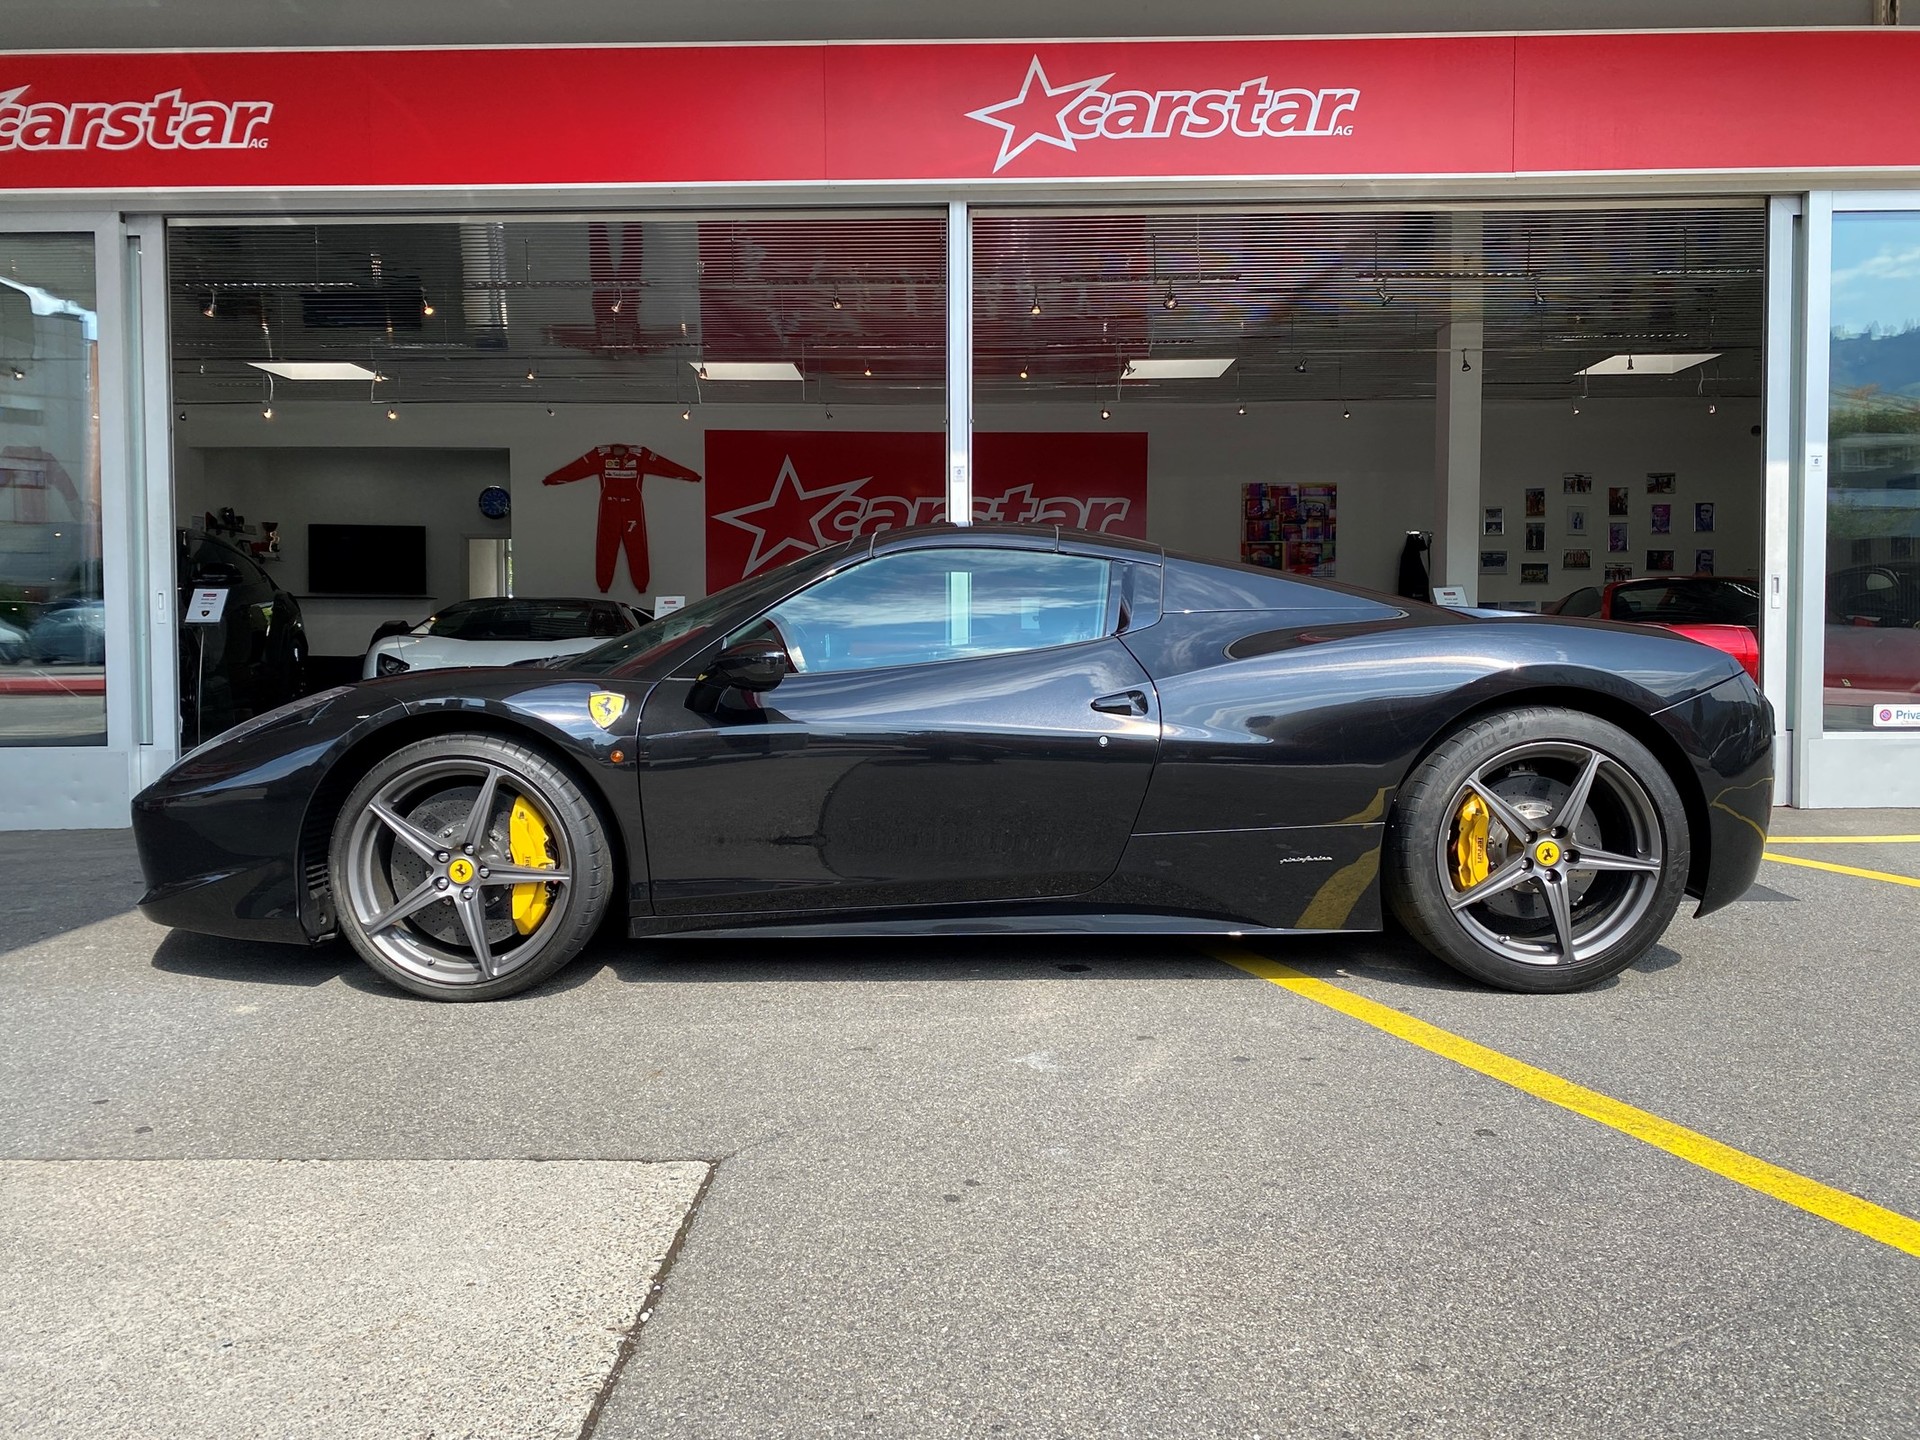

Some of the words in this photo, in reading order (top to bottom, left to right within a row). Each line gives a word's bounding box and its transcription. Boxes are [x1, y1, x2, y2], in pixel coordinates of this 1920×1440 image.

[0, 88, 274, 150] carstar
[249, 138, 268, 149] AG
[1065, 76, 1360, 139] carstar
[1333, 125, 1354, 136] AG
[627, 520, 637, 532] 7
[812, 483, 1130, 544] cartar
